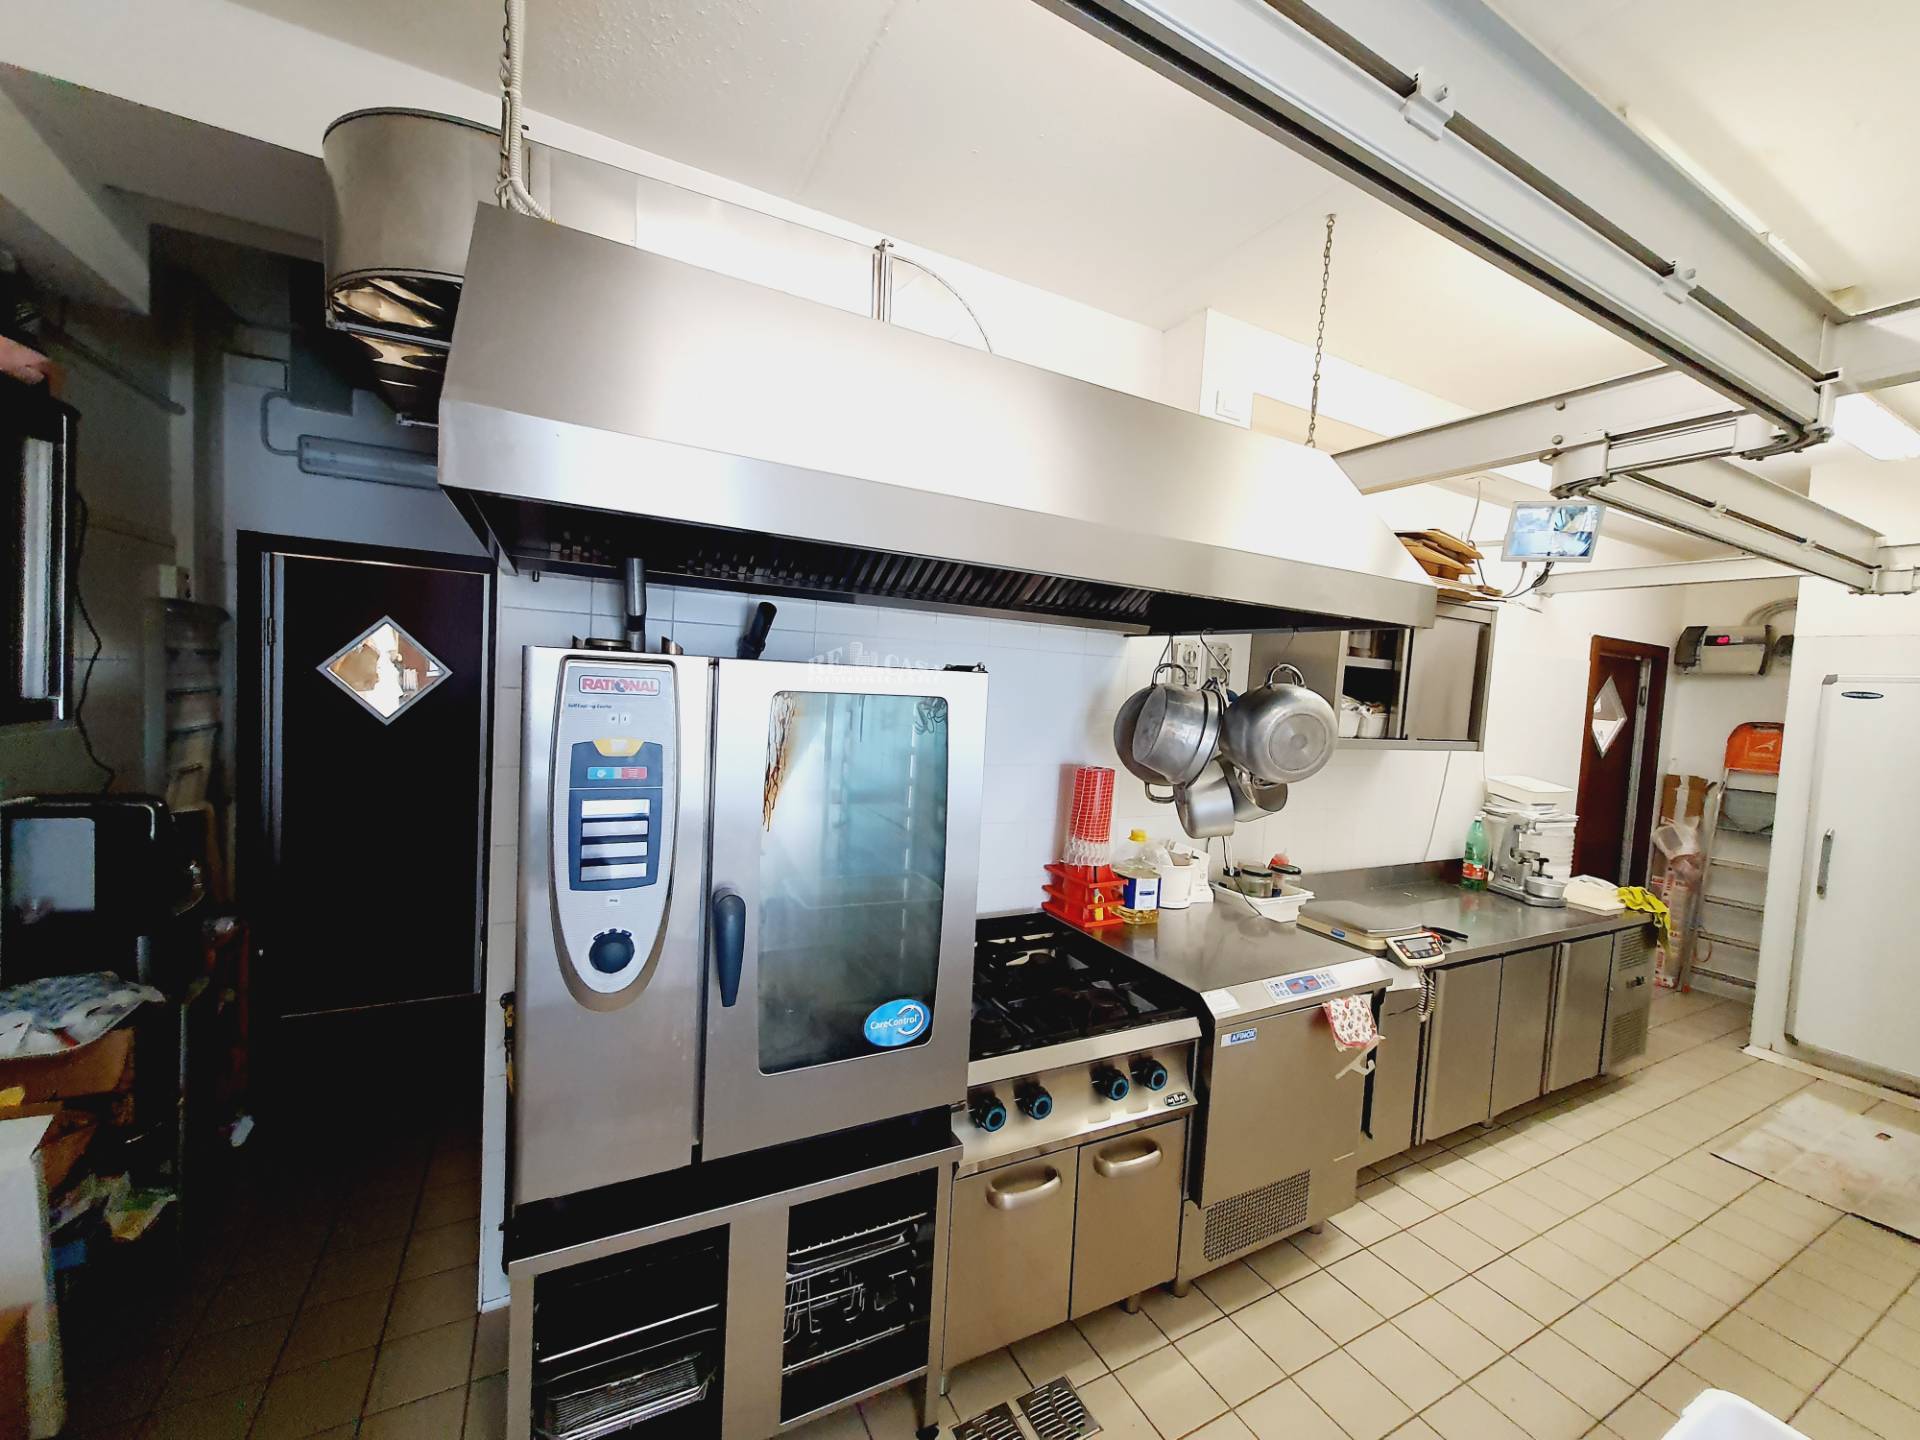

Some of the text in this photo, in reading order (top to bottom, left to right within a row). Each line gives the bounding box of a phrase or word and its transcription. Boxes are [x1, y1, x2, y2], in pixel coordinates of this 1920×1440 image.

[582, 678, 658, 692] RATIONAL
[870, 1015, 917, 1030] CareControl
[1231, 1030, 1256, 1042] AFINOX
